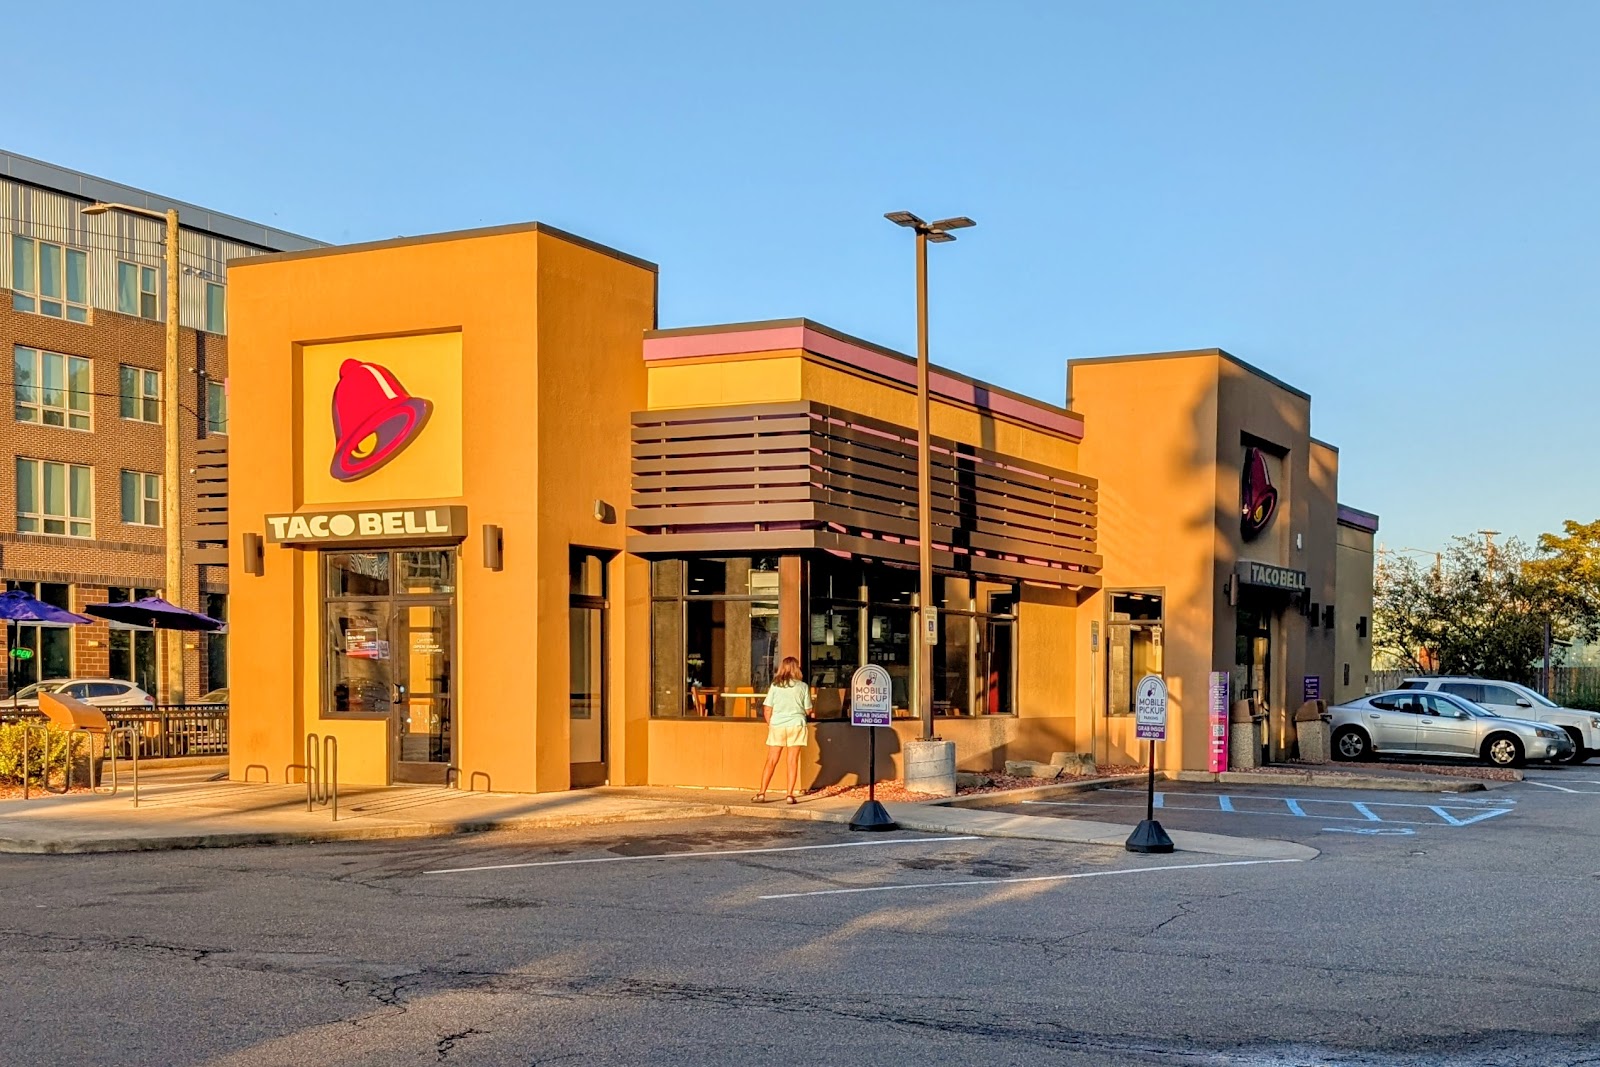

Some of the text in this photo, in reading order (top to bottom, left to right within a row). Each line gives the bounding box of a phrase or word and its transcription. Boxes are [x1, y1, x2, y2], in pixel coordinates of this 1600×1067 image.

[268, 510, 448, 539] TACO BELL
[1252, 565, 1305, 589] TACO BELL
[856, 687, 887, 695] MOBILE
[856, 694, 887, 702] PICKUP
[1139, 698, 1164, 706] MOBILE
[1139, 707, 1164, 715] PICKUP
